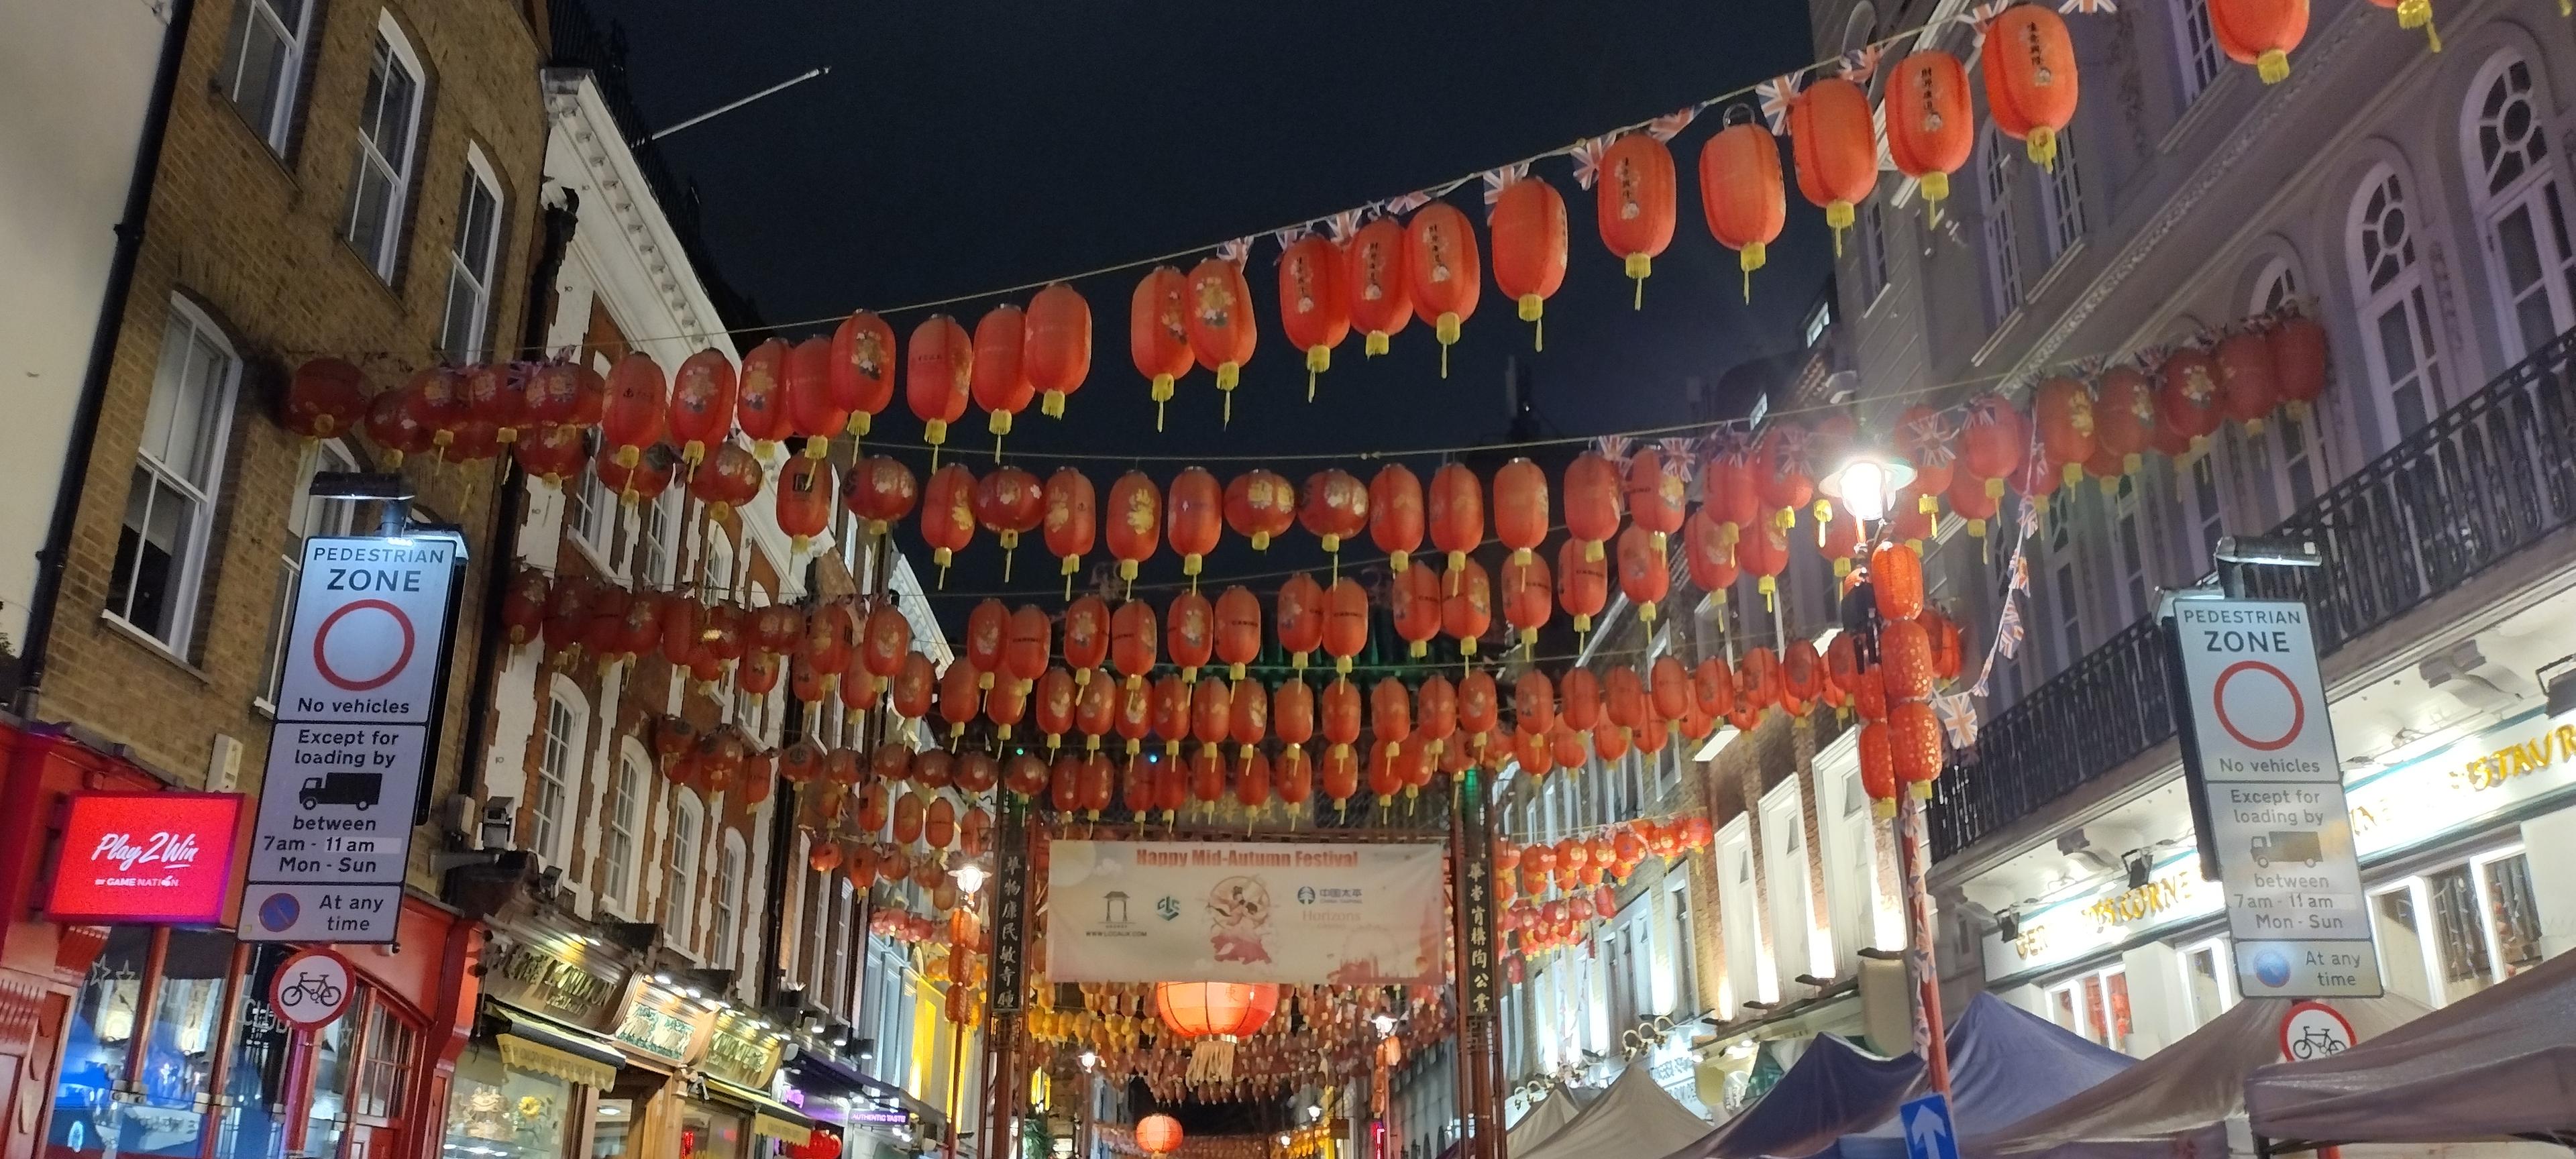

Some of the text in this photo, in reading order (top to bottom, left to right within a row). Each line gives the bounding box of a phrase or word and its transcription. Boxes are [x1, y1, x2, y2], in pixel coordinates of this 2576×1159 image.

[313, 547, 444, 563] PEDESTRIAN
[327, 568, 421, 592] ZONE
[2184, 610, 2301, 624] PEDESTRIAN
[2204, 630, 2290, 653] ZONE
[297, 697, 410, 714] No vehicles
[297, 729, 399, 747] Except for
[294, 749, 396, 768] loading by
[2219, 758, 2320, 773] No vehicles
[2231, 789, 2320, 805] Except for
[292, 815, 376, 831] between
[2233, 808, 2324, 826] loading by
[264, 836, 305, 851] 7am
[279, 857, 320, 872] Mon
[338, 857, 376, 872] Sun
[1136, 849, 1358, 867] Happy Mid-Autumn Festival
[106, 877, 136, 887] GAME
[136, 875, 179, 887] NATION
[2255, 873, 2330, 888] between
[319, 895, 384, 913] At any
[2234, 893, 2272, 908] 7am
[327, 916, 370, 931] time
[2255, 914, 2294, 929] Mon
[2309, 914, 2344, 929] Sun
[2306, 950, 2361, 969] At any
[2317, 972, 2356, 987] time
[852, 1113, 887, 1122] AUTHENTIC
